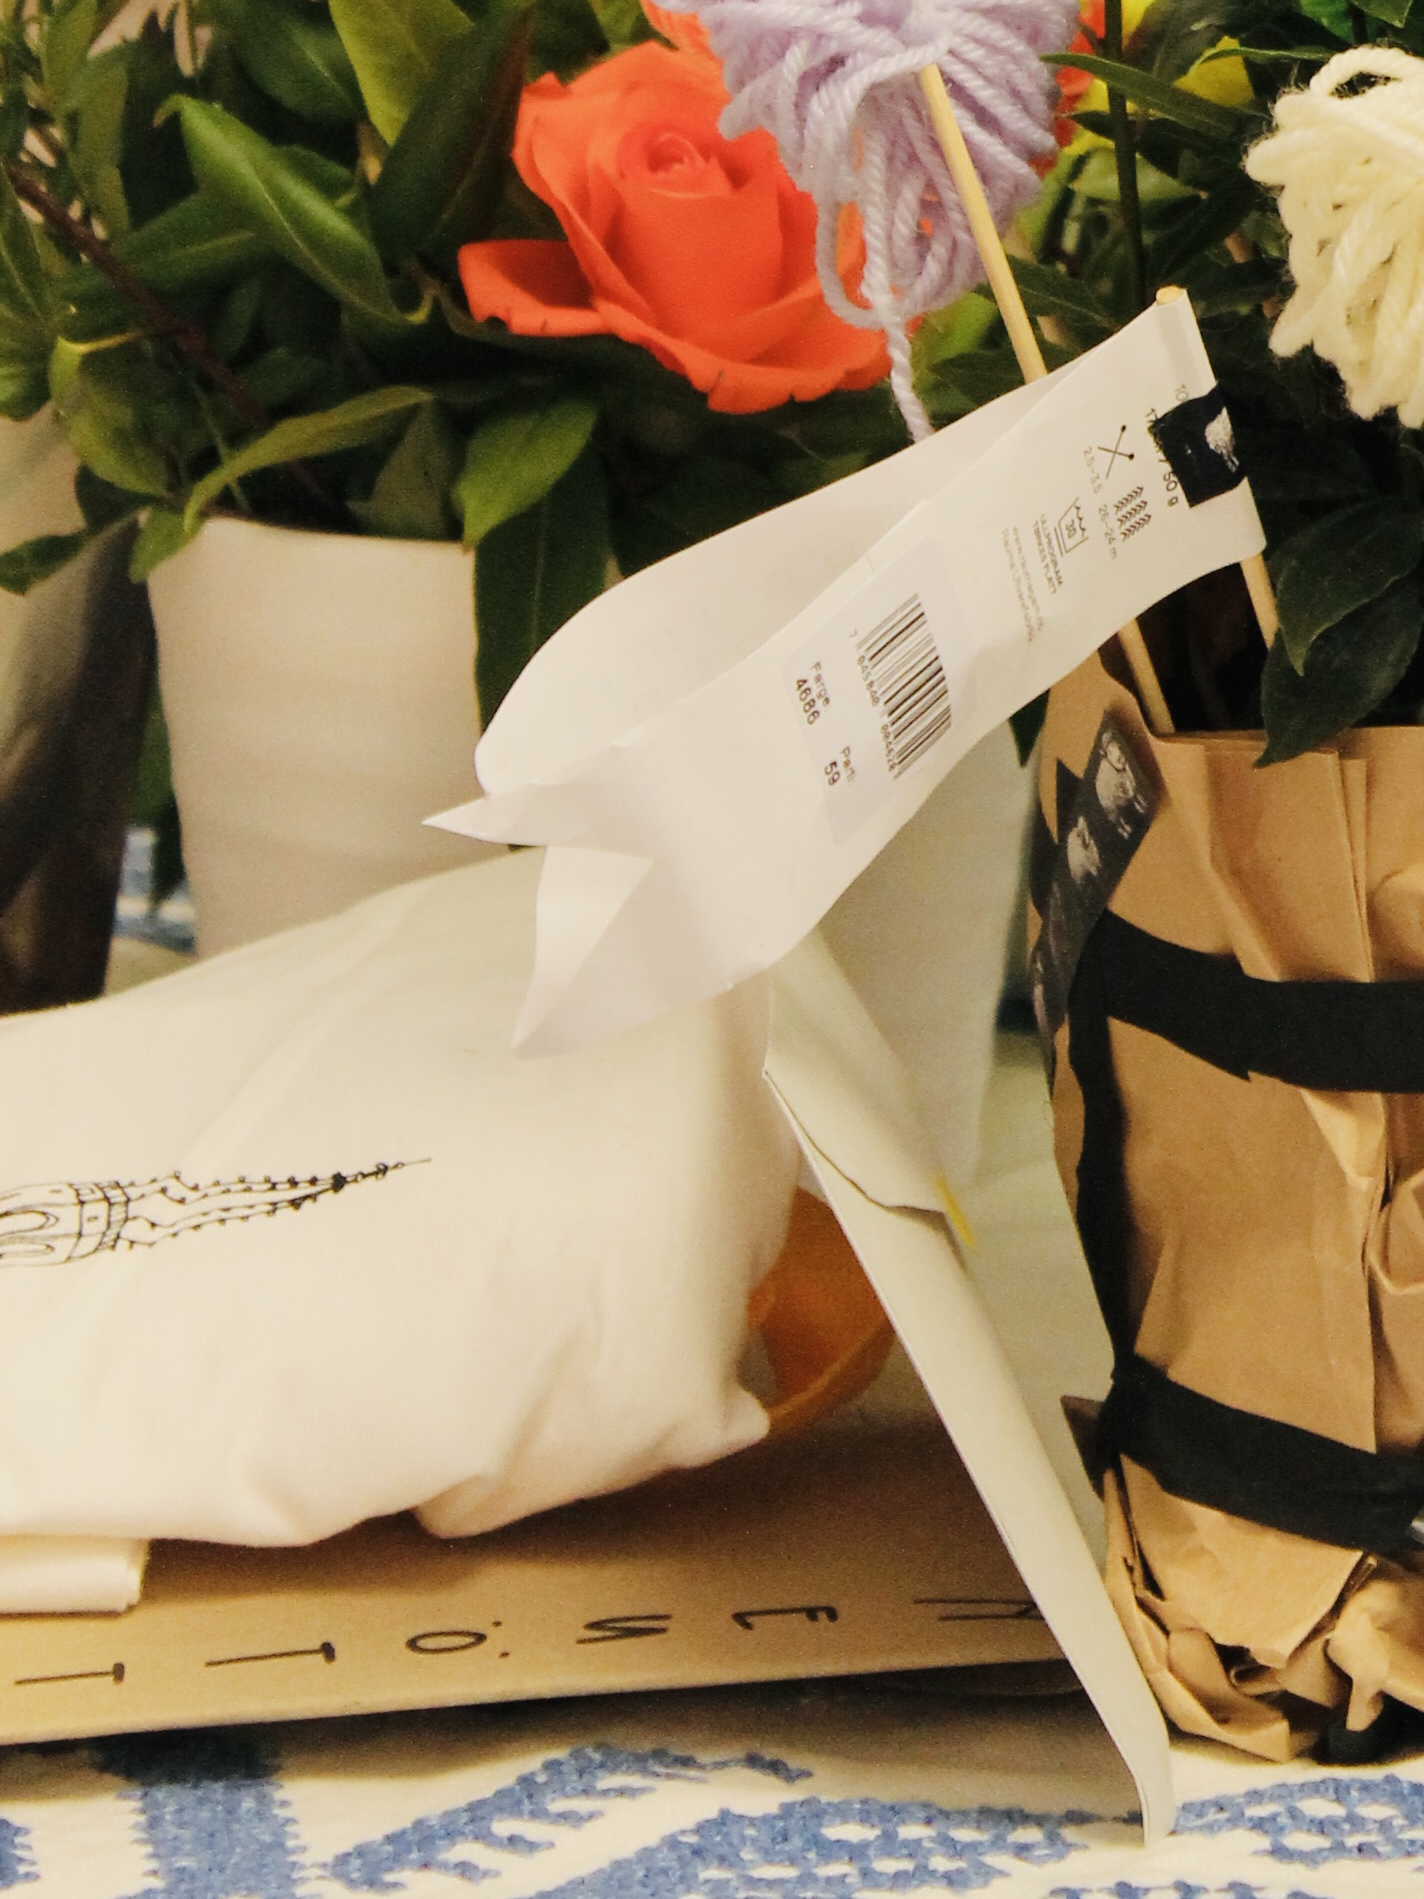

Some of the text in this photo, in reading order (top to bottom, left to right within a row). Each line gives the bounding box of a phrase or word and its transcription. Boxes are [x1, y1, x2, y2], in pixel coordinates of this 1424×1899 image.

[1163, 471, 1178, 492] 50
[1167, 496, 1179, 507] g
[1065, 519, 1077, 539] 30
[795, 678, 841, 786] 4686 59
